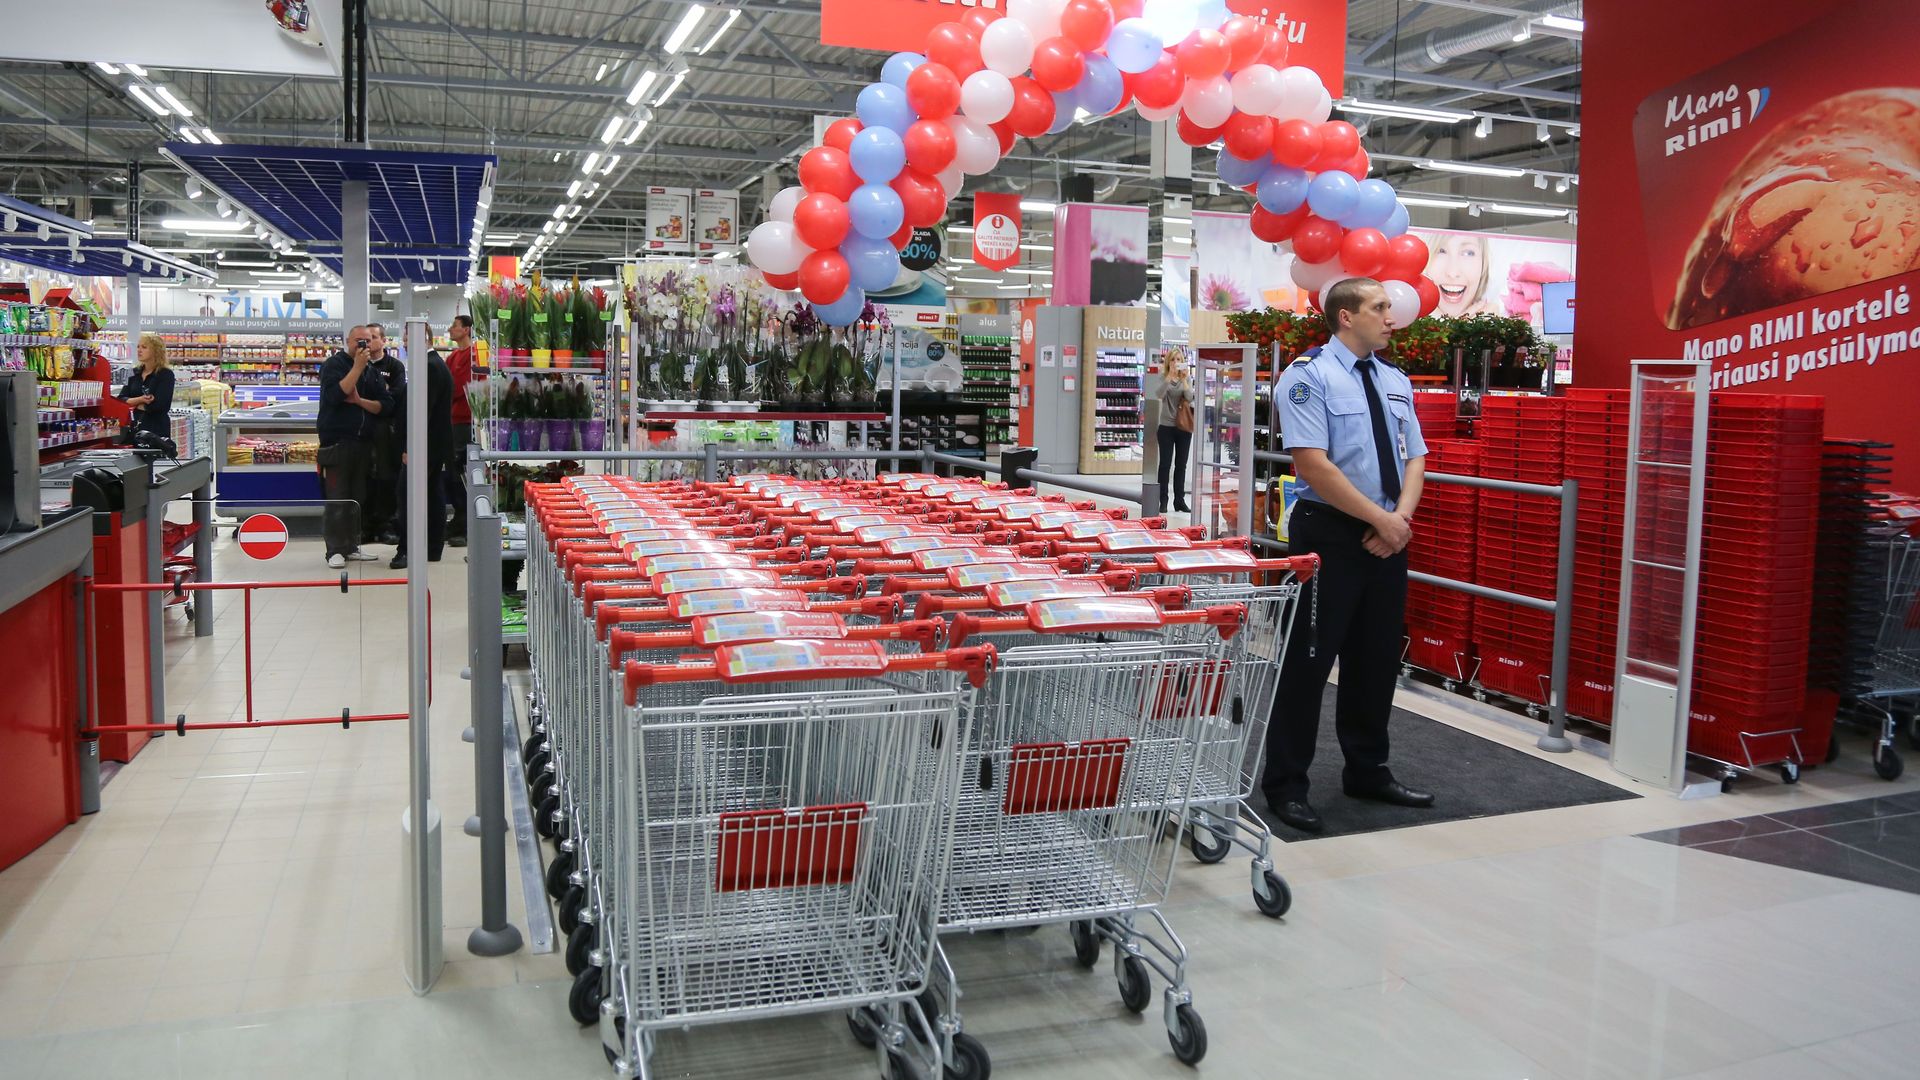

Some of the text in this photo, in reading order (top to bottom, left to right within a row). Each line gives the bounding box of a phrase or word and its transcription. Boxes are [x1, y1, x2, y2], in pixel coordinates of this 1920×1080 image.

[1664, 84, 1739, 128] Mano
[162, 318, 217, 328] sausi pusryčiai
[225, 319, 280, 329] sausi pusryčiai
[308, 320, 341, 329] pusryčiai
[979, 317, 997, 327] alus
[1683, 284, 1910, 361] Mano RIMI kortelė
[1097, 326, 1145, 341] Natūra
[1689, 711, 1708, 722] imi
